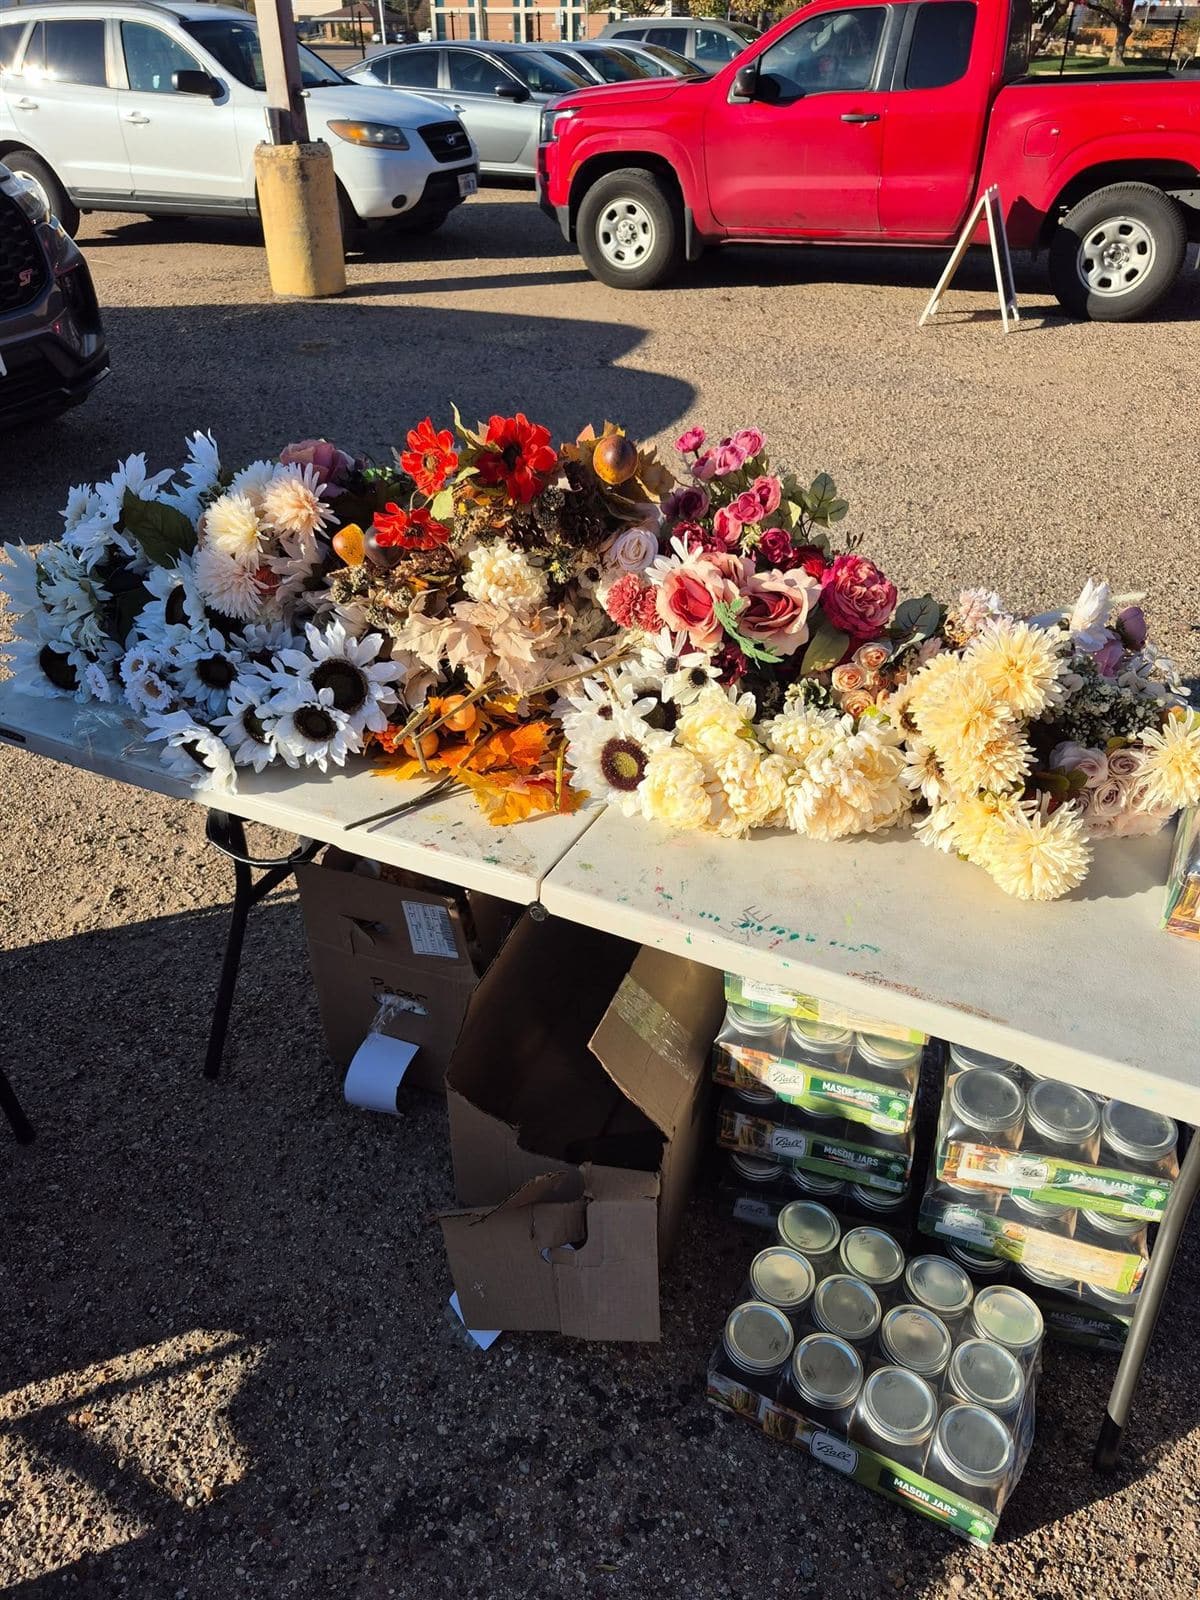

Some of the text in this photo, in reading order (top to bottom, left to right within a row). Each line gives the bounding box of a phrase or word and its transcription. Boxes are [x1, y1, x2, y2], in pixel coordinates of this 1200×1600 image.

[771, 1070, 801, 1085] Ball
[775, 1136, 802, 1148] Ball
[823, 1144, 855, 1161] MASON
[857, 1154, 879, 1167] JARS
[816, 1440, 852, 1463] Ball
[893, 1476, 930, 1502] MASON
[930, 1498, 959, 1518] JARS
